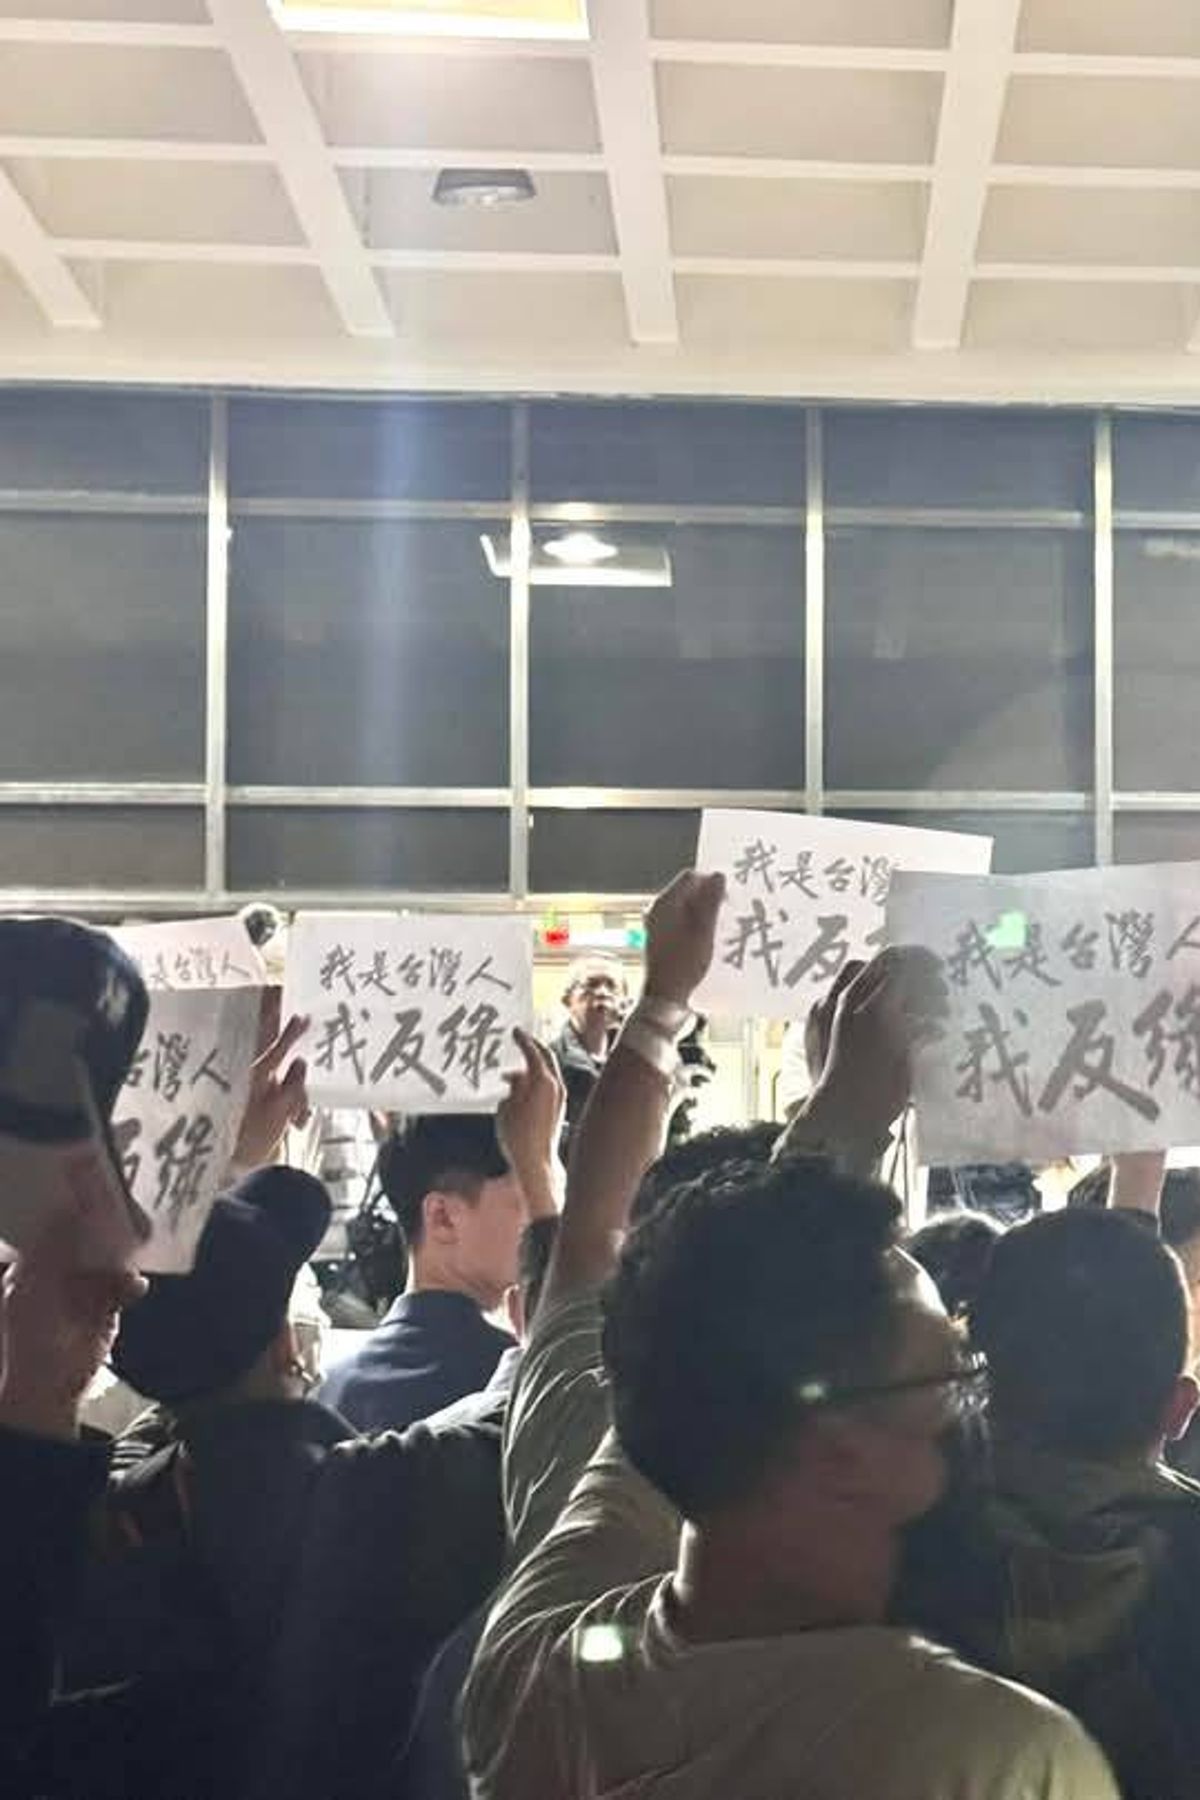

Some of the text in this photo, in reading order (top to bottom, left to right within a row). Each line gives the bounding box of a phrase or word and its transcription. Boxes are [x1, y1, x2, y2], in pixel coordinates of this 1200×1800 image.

[146, 945, 251, 992] 是台灣人
[319, 944, 512, 997] 我是台灣人
[722, 899, 890, 988] 我反
[315, 1002, 504, 1094] 我反綠
